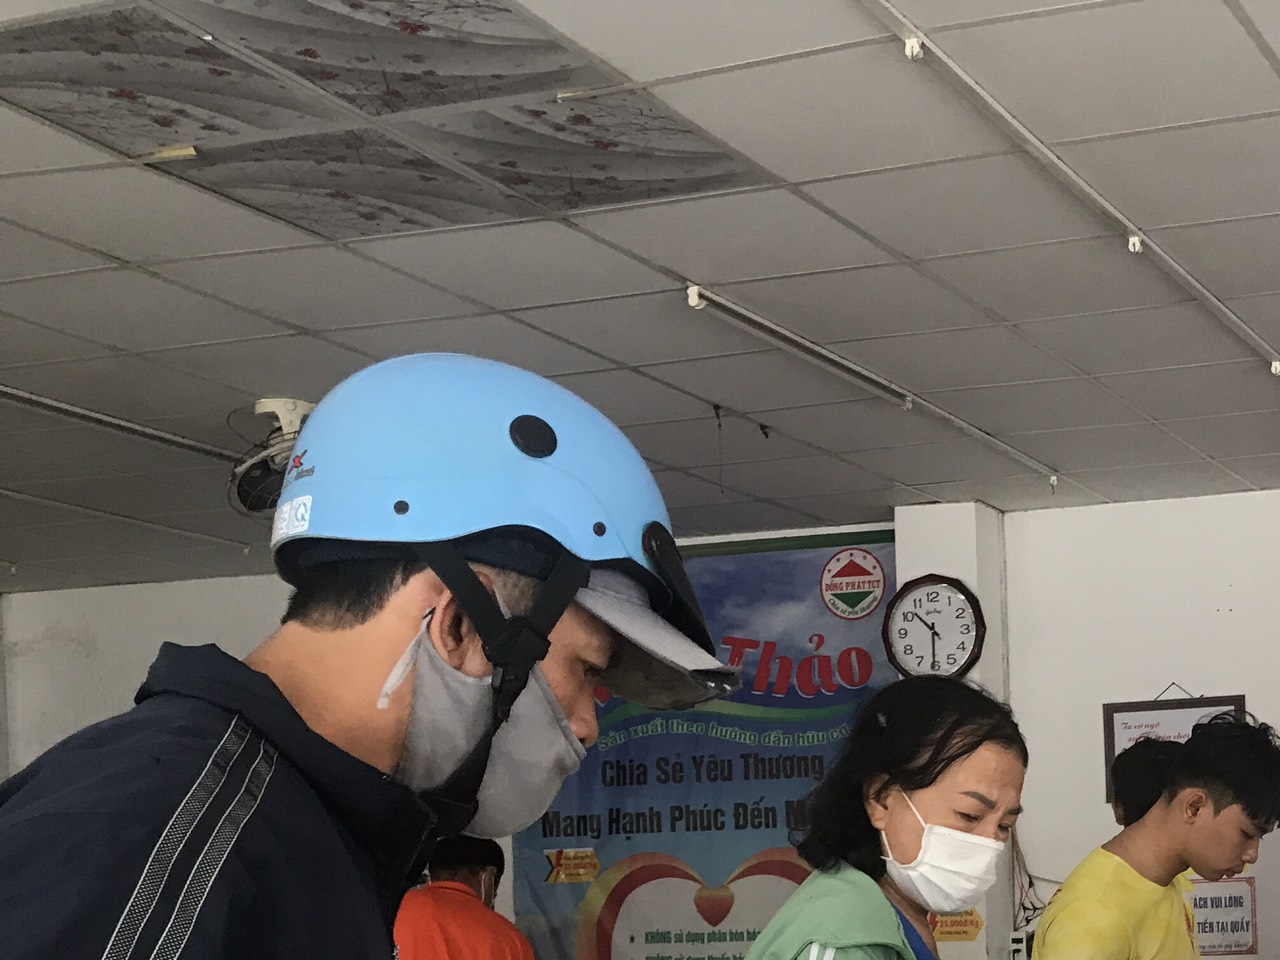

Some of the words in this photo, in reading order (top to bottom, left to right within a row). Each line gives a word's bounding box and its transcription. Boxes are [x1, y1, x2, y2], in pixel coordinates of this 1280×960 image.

[926, 591, 940, 603] 12
[947, 595, 951, 607] 1
[913, 598, 922, 609] 11
[902, 611, 915, 622] 10
[955, 607, 966, 619] 2
[898, 628, 908, 639] 9
[960, 623, 971, 635] 3
[903, 644, 914, 655] 8
[956, 641, 967, 652] 4
[915, 655, 924, 667] 7
[946, 653, 957, 665] 5
[721, 633, 873, 698] Thảo
[667, 719, 705, 735] theo
[601, 758, 648, 788] Chia
[655, 753, 685, 785] Sẻ
[691, 754, 733, 782] Yêu
[739, 752, 824, 782] Thương
[541, 809, 601, 840] Mang
[608, 805, 662, 841] Hạnh
[669, 802, 726, 833] Phúc
[733, 796, 778, 831] Đến
[1193, 894, 1208, 909] ÁCH
[1210, 896, 1223, 909] VUI
[644, 929, 672, 944] KHÔNG
